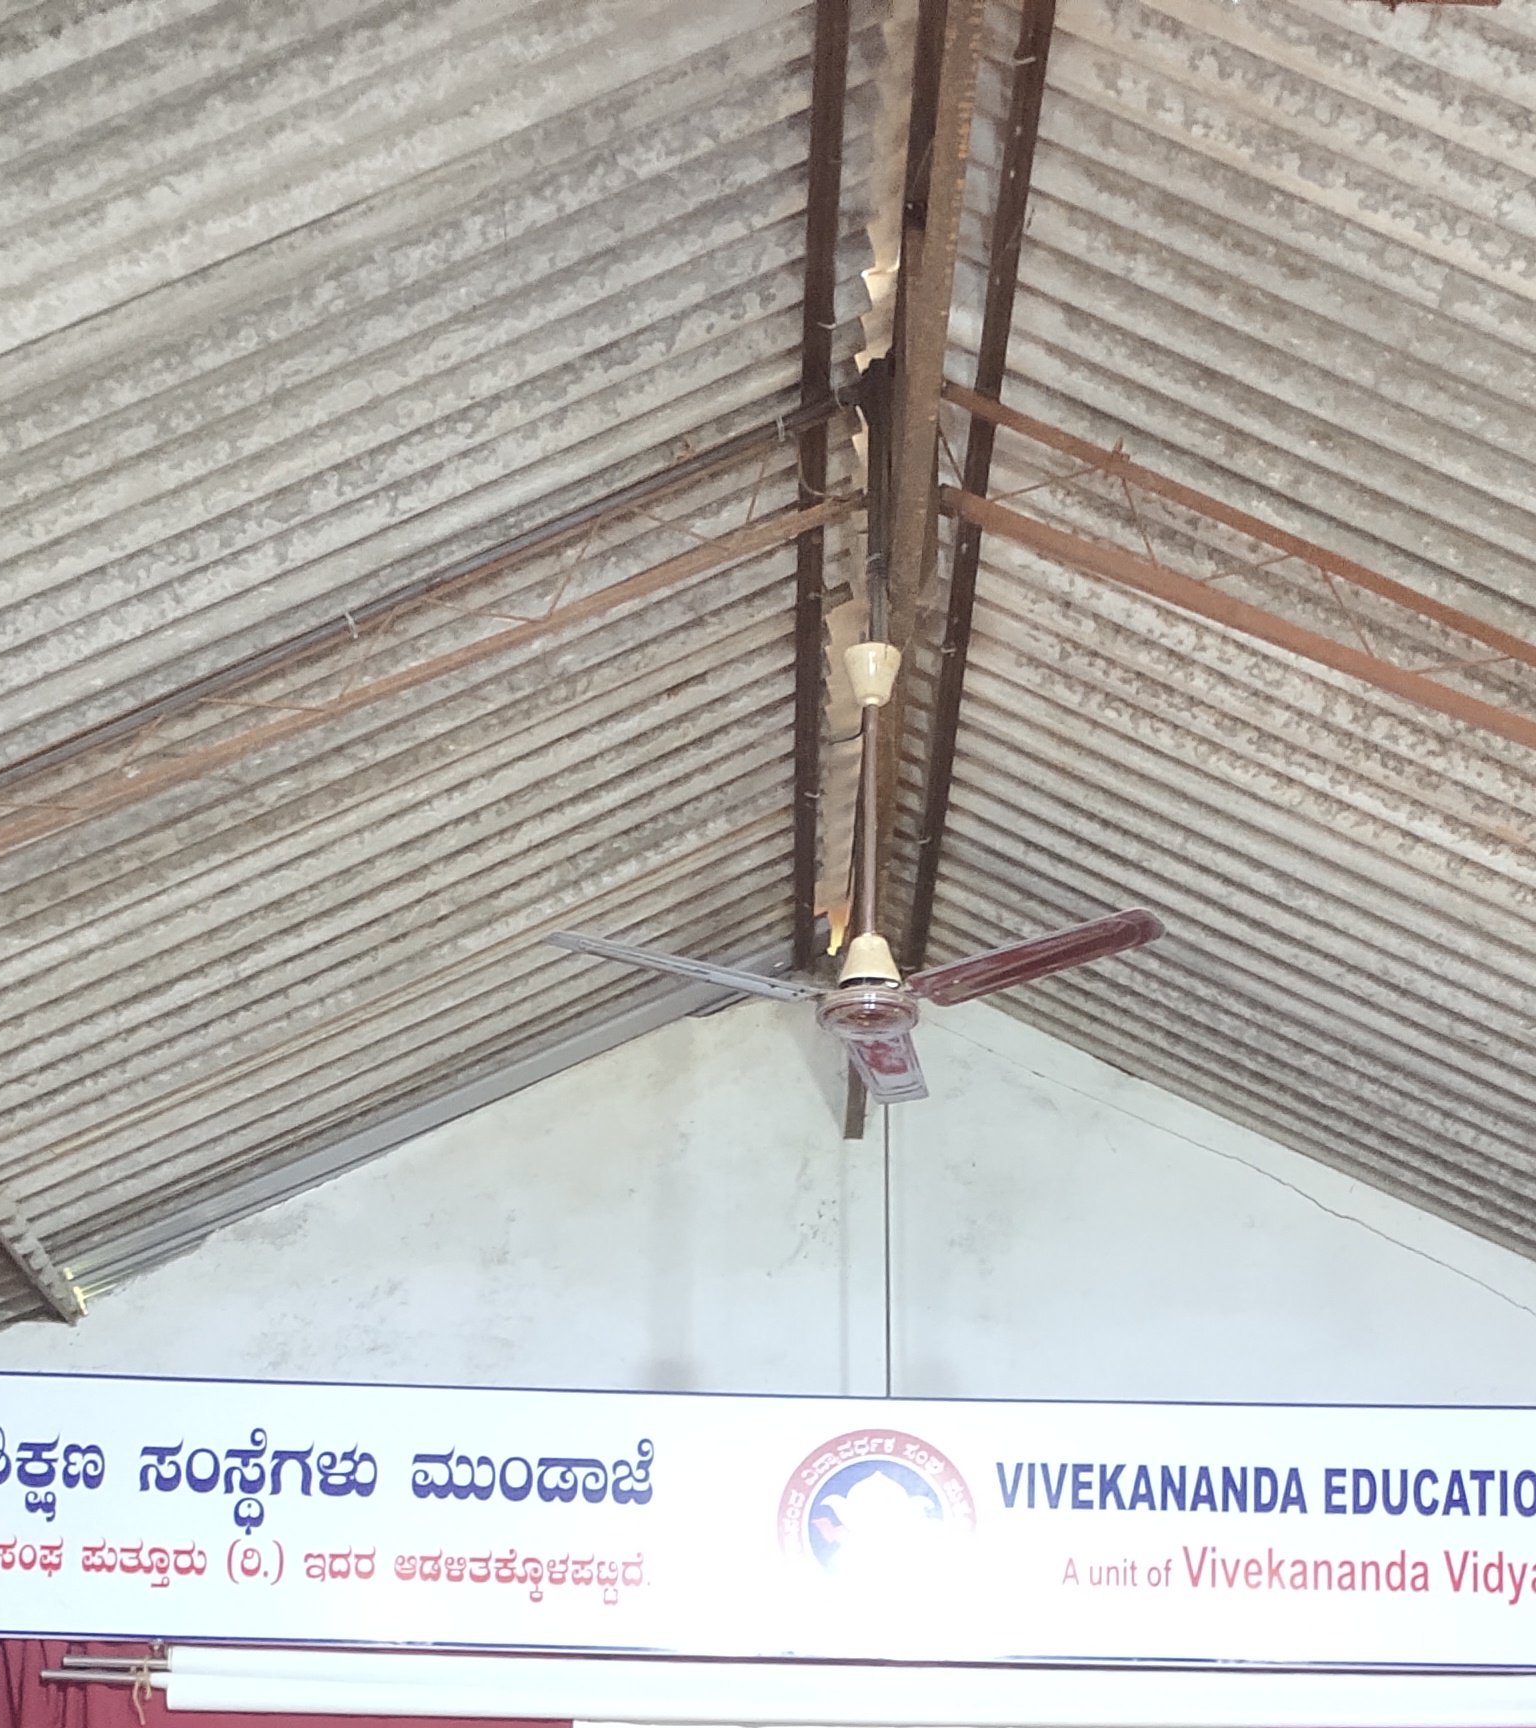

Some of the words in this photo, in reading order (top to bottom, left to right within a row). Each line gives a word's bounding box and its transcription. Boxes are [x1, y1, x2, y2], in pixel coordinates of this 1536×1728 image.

[138, 1427, 379, 1536] ಸಂಸ್ಥೆಗಳು
[411, 1437, 655, 1505] ಮುಂಡಾಜೆ
[995, 1461, 1308, 1515] VIVEKANANDA
[81, 1539, 208, 1588] ಪುತ್ತೂರು
[226, 1538, 285, 1586] (ರಿ.)
[303, 1545, 377, 1583] ಇದರ
[1061, 1557, 1080, 1586] A
[1089, 1558, 1137, 1587] unit
[1147, 1558, 1173, 1588] of
[1181, 1545, 1430, 1593] Vivekananda
